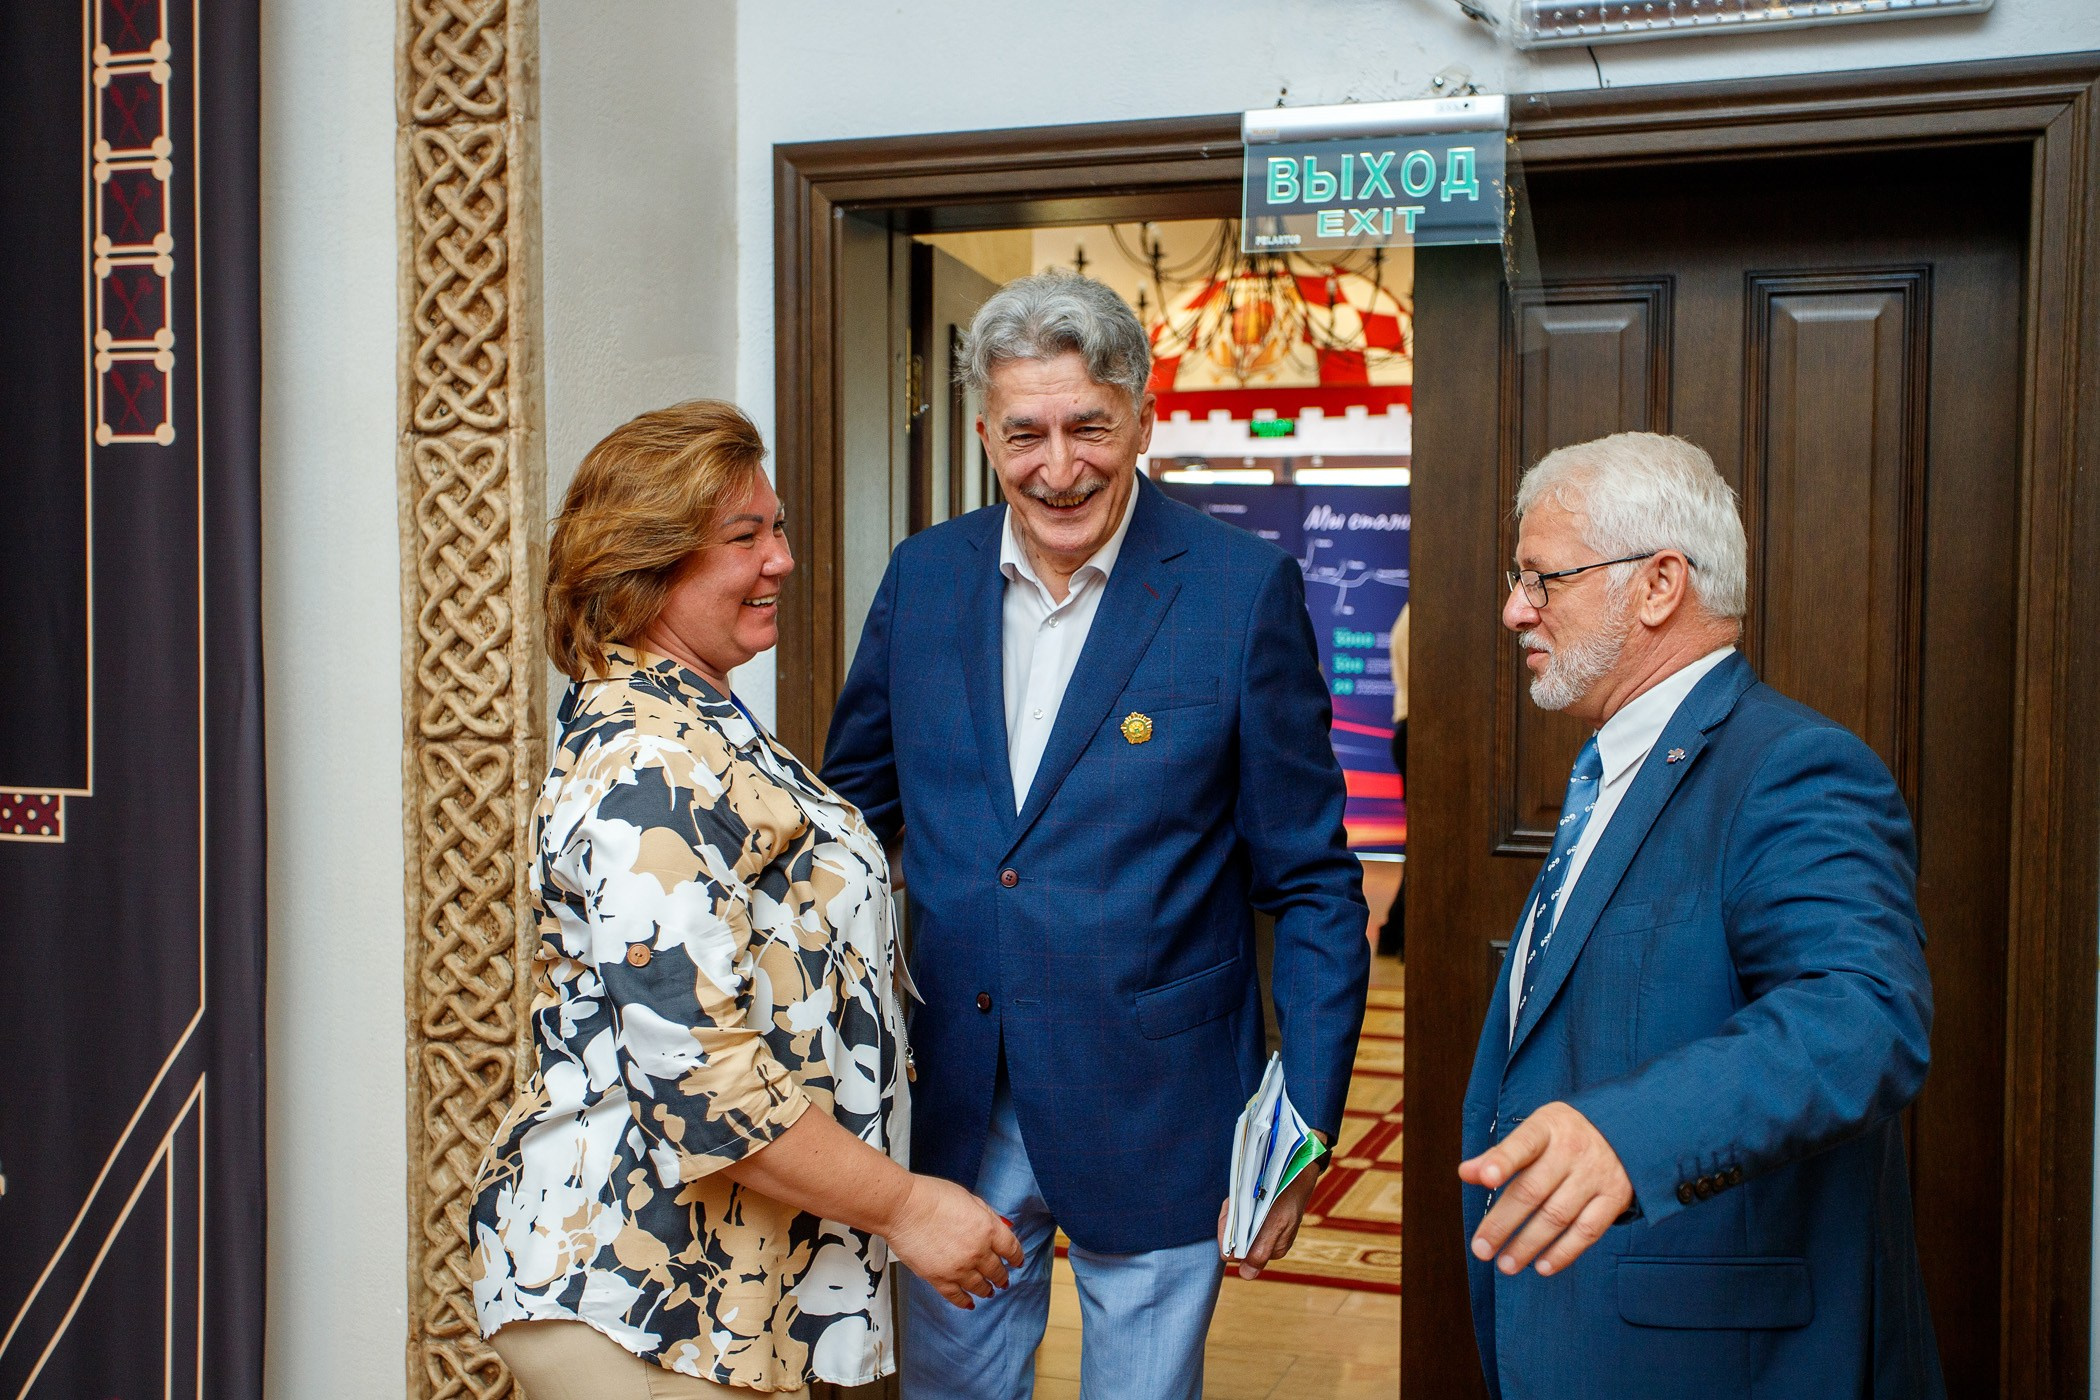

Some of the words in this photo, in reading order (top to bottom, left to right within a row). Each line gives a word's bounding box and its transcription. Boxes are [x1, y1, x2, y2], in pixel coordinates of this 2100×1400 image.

[1266, 147, 1480, 205] ВЫХОД
[1316, 205, 1426, 238] EXIT
[1303, 504, 1346, 531] Мы
